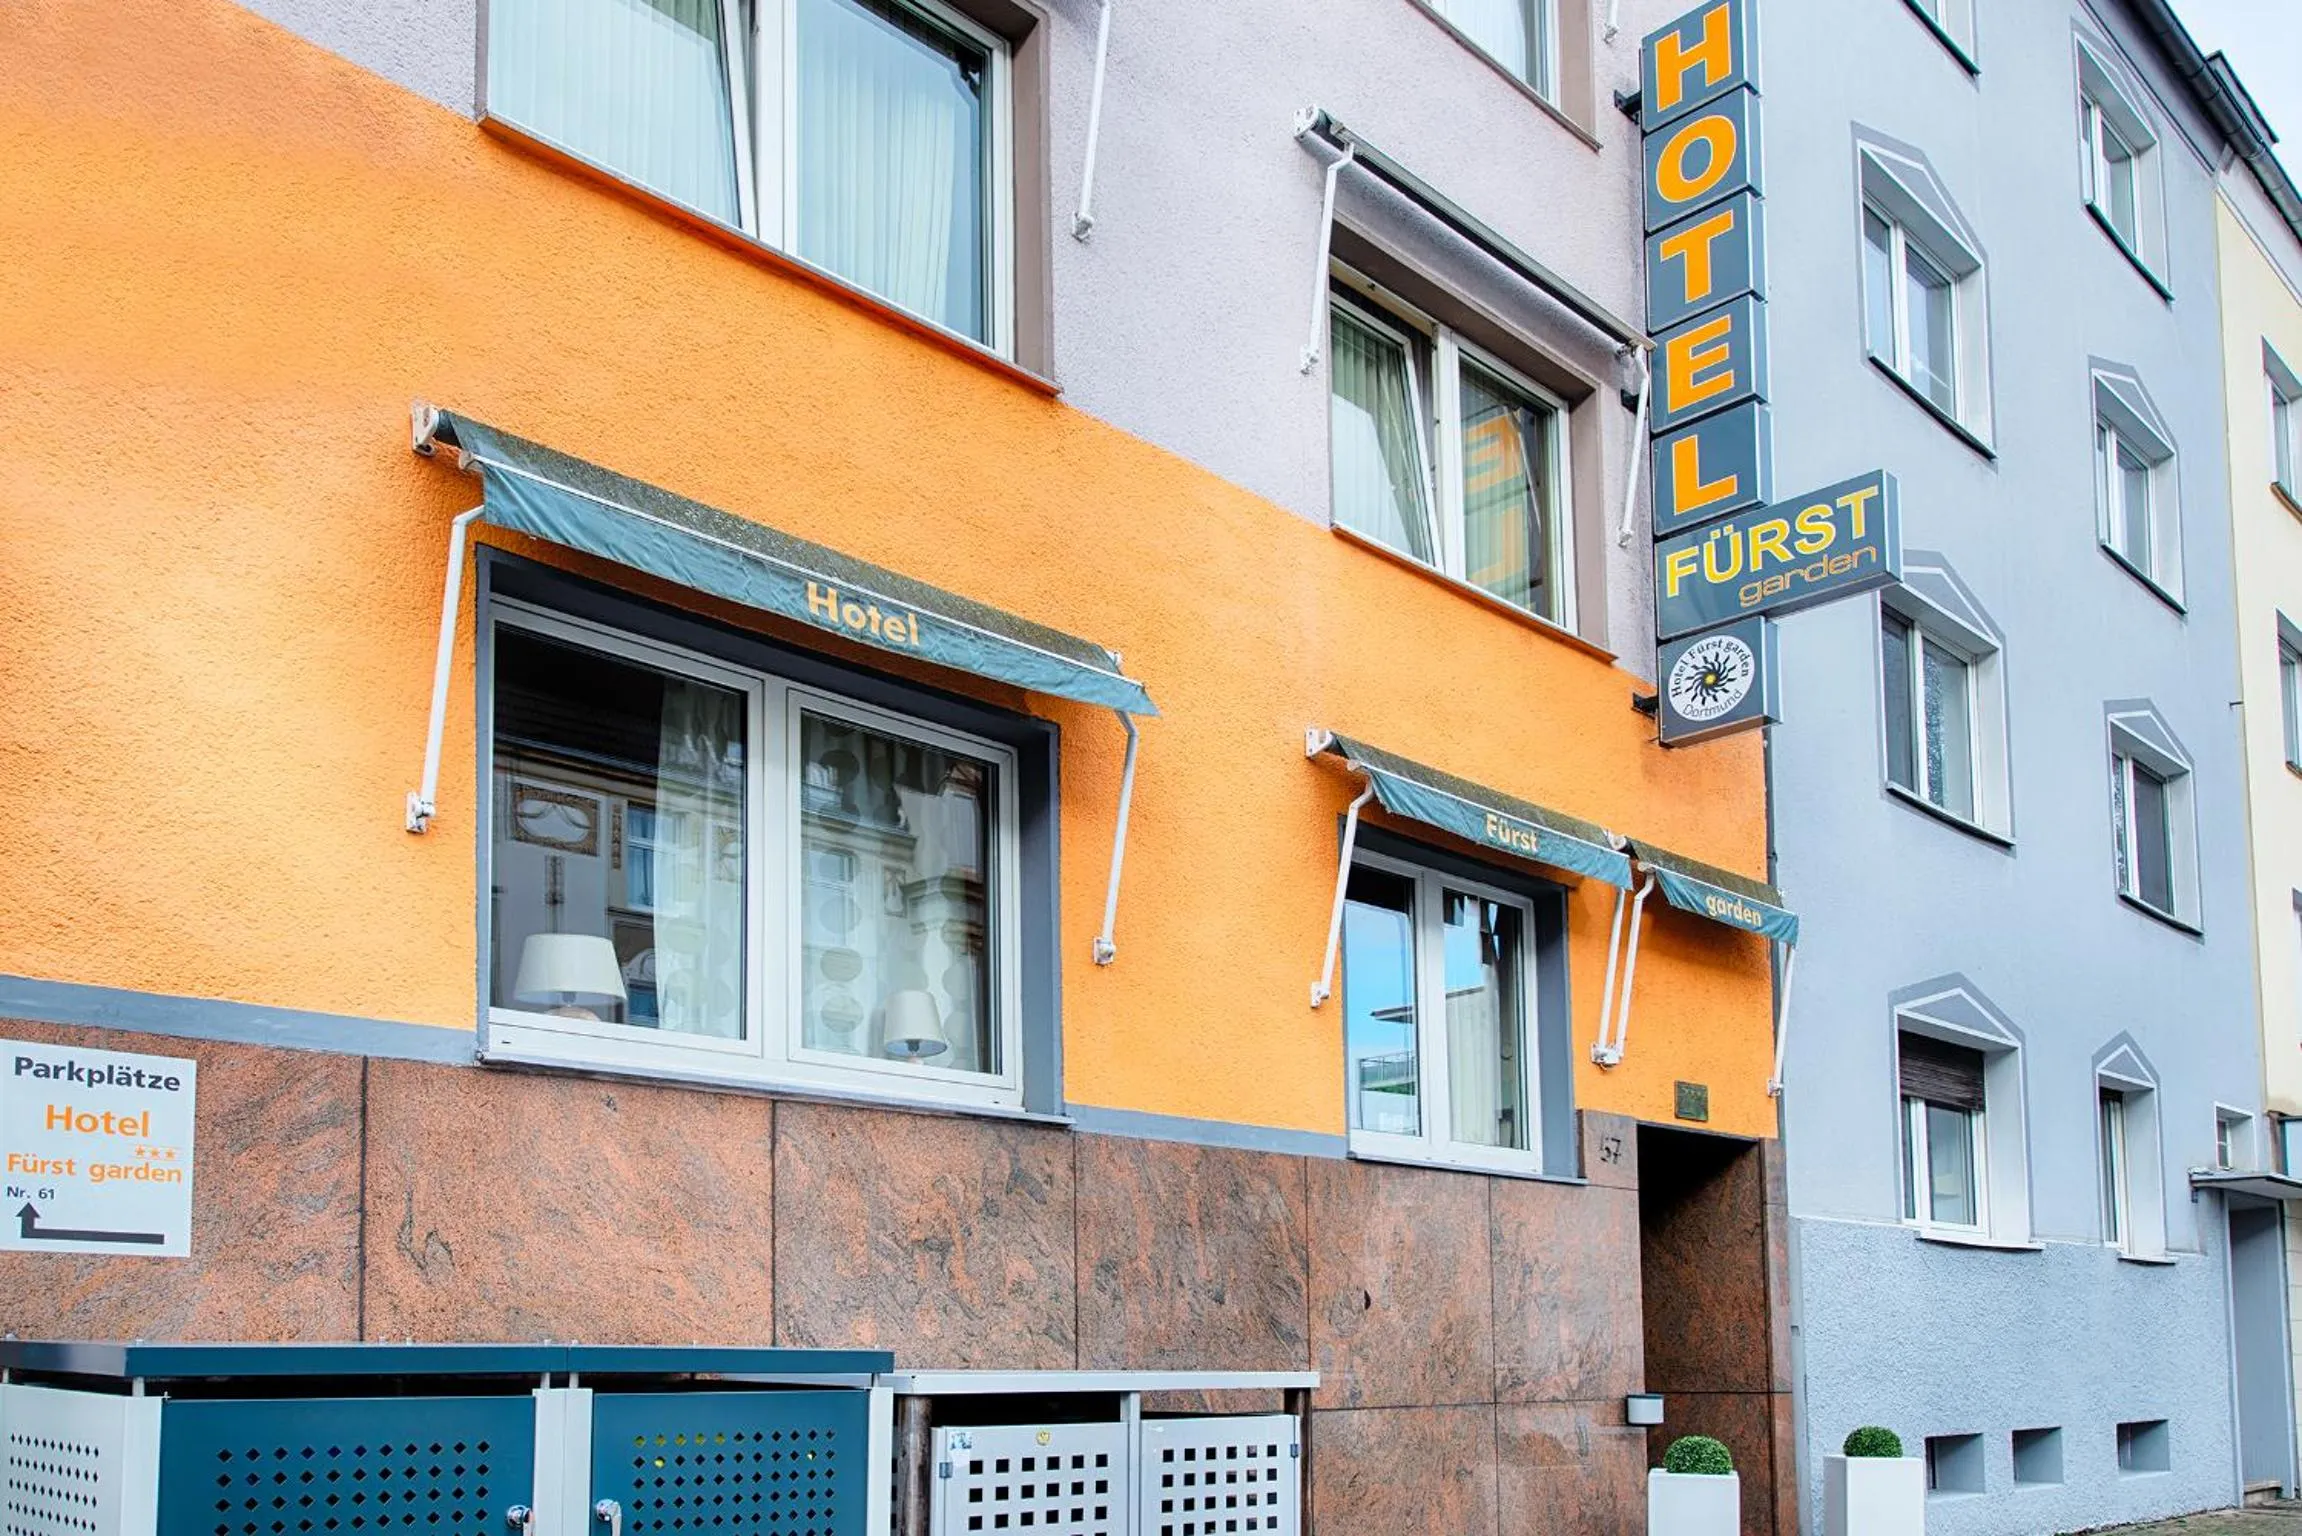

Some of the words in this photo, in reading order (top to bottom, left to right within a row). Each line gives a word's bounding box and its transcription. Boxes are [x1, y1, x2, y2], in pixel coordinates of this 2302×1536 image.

[1655, 2, 1737, 517] HOTEL
[1665, 484, 1879, 598] FÜRST
[1738, 545, 1877, 608] garden
[807, 580, 921, 646] Hotel
[1671, 658, 1690, 698] Hotel
[1687, 638, 1722, 660] Fürst
[1723, 640, 1751, 678] garden
[1682, 688, 1743, 718] Dortmund
[1485, 813, 1538, 852] Fürst
[1705, 893, 1763, 926] garden
[14, 1055, 181, 1092] Parkplätze
[45, 1103, 151, 1138] Hotel
[1600, 1129, 1622, 1165] 57
[7, 1152, 77, 1177] Fürst
[88, 1162, 182, 1184] garden
[6, 1185, 32, 1200] Nr.
[37, 1187, 56, 1200] 61
